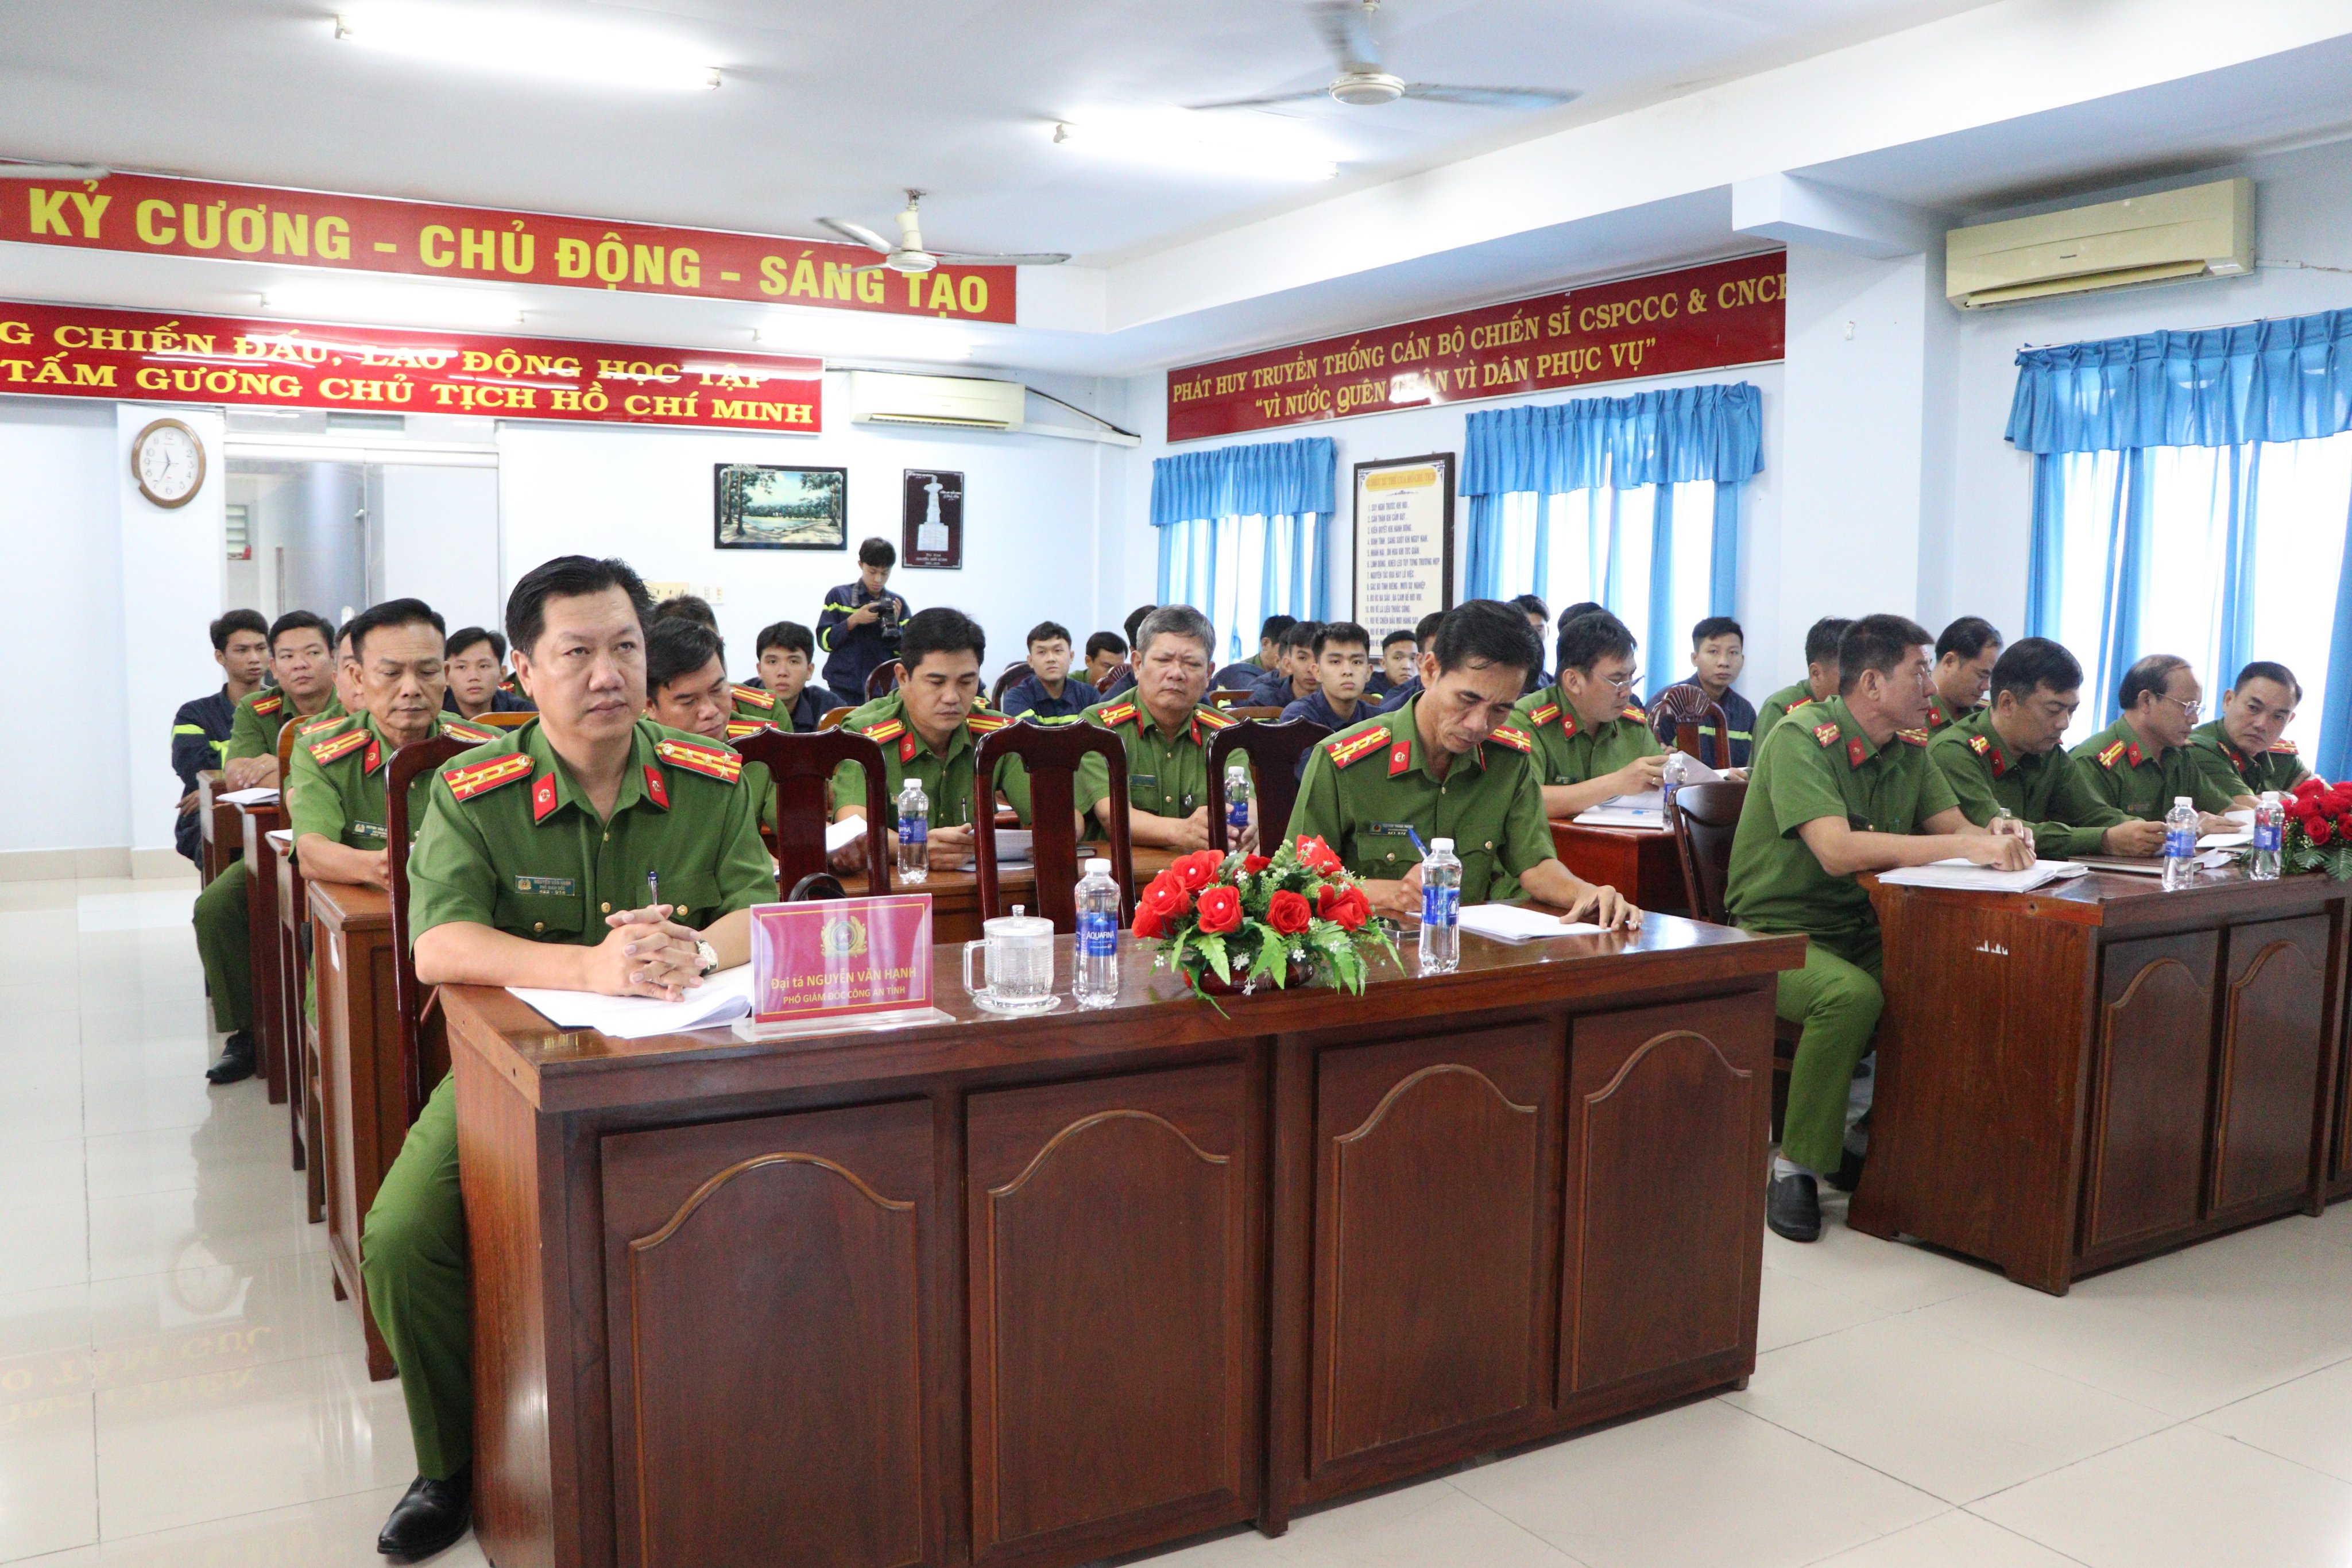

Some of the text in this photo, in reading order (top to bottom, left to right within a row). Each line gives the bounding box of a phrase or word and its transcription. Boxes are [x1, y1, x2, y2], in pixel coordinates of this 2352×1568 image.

[29, 179, 112, 239] KỶ
[136, 199, 350, 260] CƯƠNG
[419, 219, 535, 274] CHỦ
[554, 231, 701, 291] ĐỘNG
[759, 250, 885, 304] SÁNG
[902, 271, 988, 319] TẠO
[53, 321, 216, 355] CHIẾN
[233, 328, 342, 366] ĐẤU,
[462, 348, 582, 378] ĐỘNG
[596, 359, 682, 386] HỌC
[699, 363, 771, 391] TẬP
[1173, 374, 1211, 403] PHÁT
[1216, 371, 1247, 395] HUY
[1252, 351, 1318, 389] TRUYỀN
[1322, 339, 1384, 376] THỐNG
[1391, 331, 1431, 362] CÁN
[1438, 325, 1465, 358] BỘ
[1471, 309, 1539, 349] CHIẾN
[1548, 305, 1571, 338] SĨ
[1580, 293, 1678, 332] CSPCCC
[1687, 288, 1707, 315] &
[0, 351, 814, 424] TẤM GƯƠNG CHỦ TỊCH HỒ CHÍ MINH
[1285, 384, 1330, 416] NƯỚC
[1337, 378, 1386, 413] QUÊN
[1454, 359, 1477, 389] VÌ
[1483, 355, 1529, 386] DÂN
[1536, 347, 1601, 380] PHỤC
[146, 469, 152, 477] 8
[186, 450, 192, 458] 2
[1086, 930, 1115, 940] AQUAFINA
[771, 967, 917, 992] Đại tá NGUYỄN VĂN HẠNH
[783, 984, 906, 1004] PHÓ GIÁM ĐỐC CÔNG AN TỈNH
